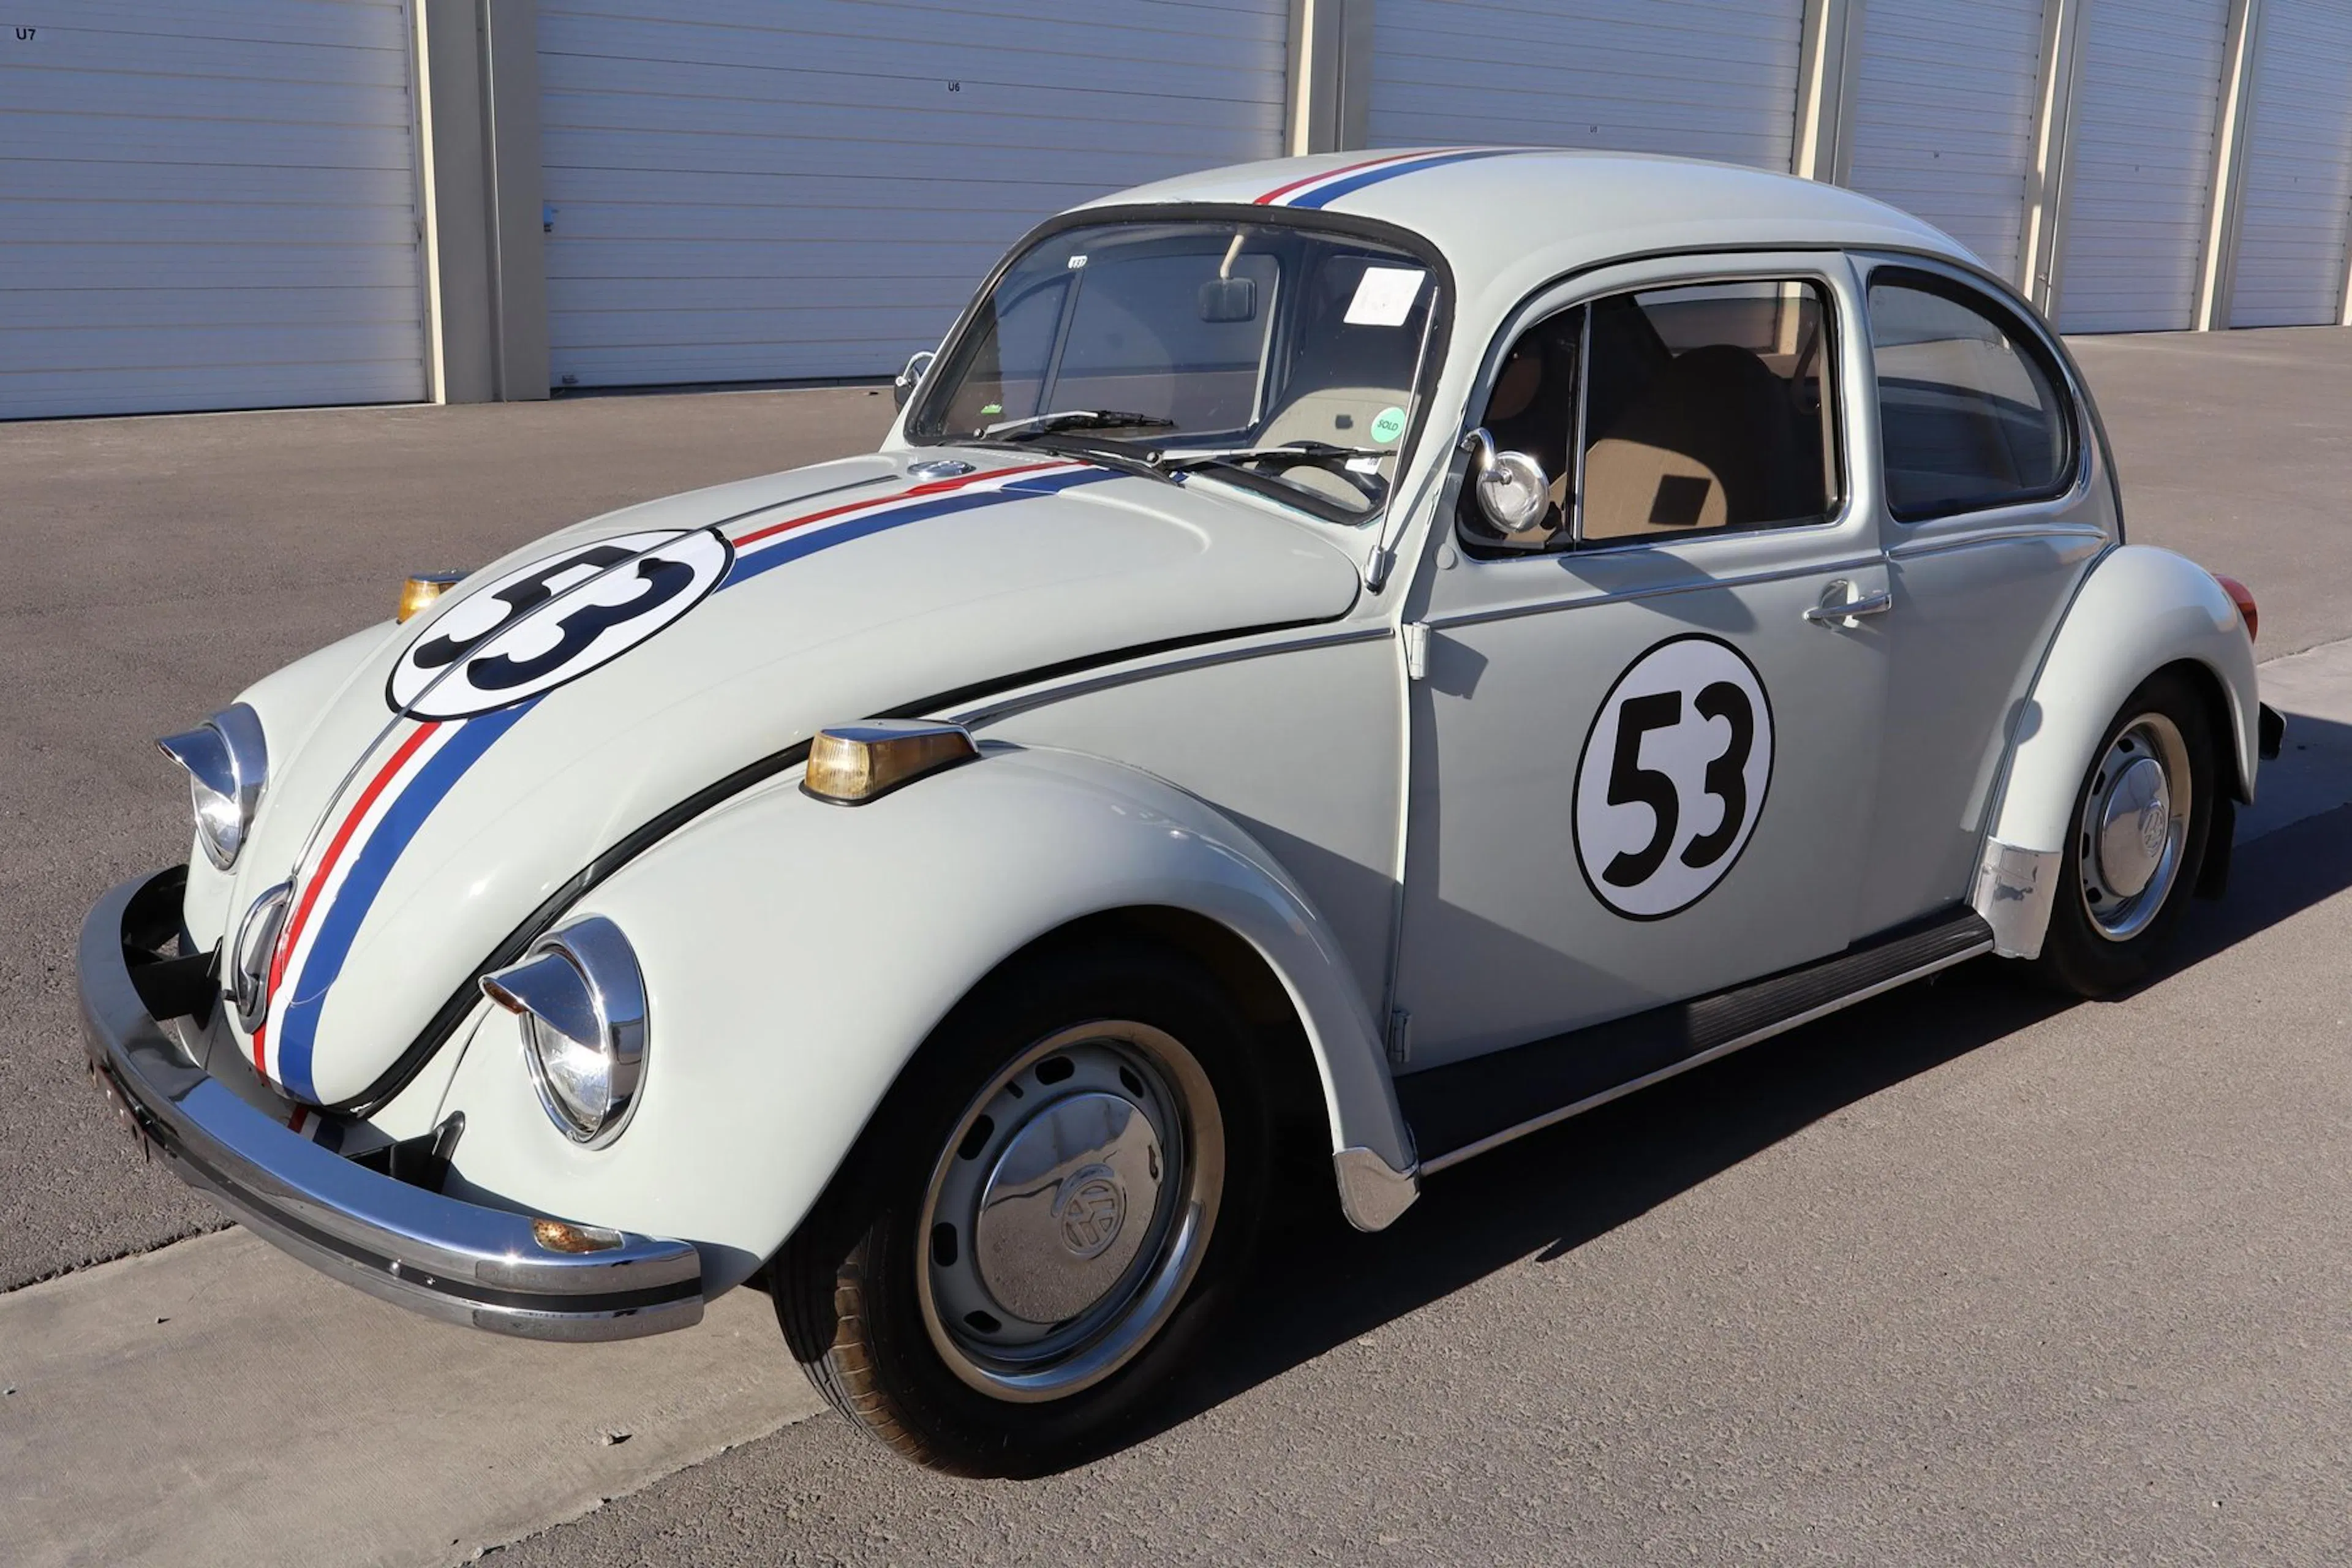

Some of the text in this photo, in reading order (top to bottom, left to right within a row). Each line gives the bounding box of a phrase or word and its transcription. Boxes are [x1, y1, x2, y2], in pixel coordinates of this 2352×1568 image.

[15, 28, 36, 40] U7
[948, 80, 960, 92] U6
[1377, 419, 1399, 431] SOLD
[413, 545, 695, 691] 53
[1602, 680, 1754, 888] 53
